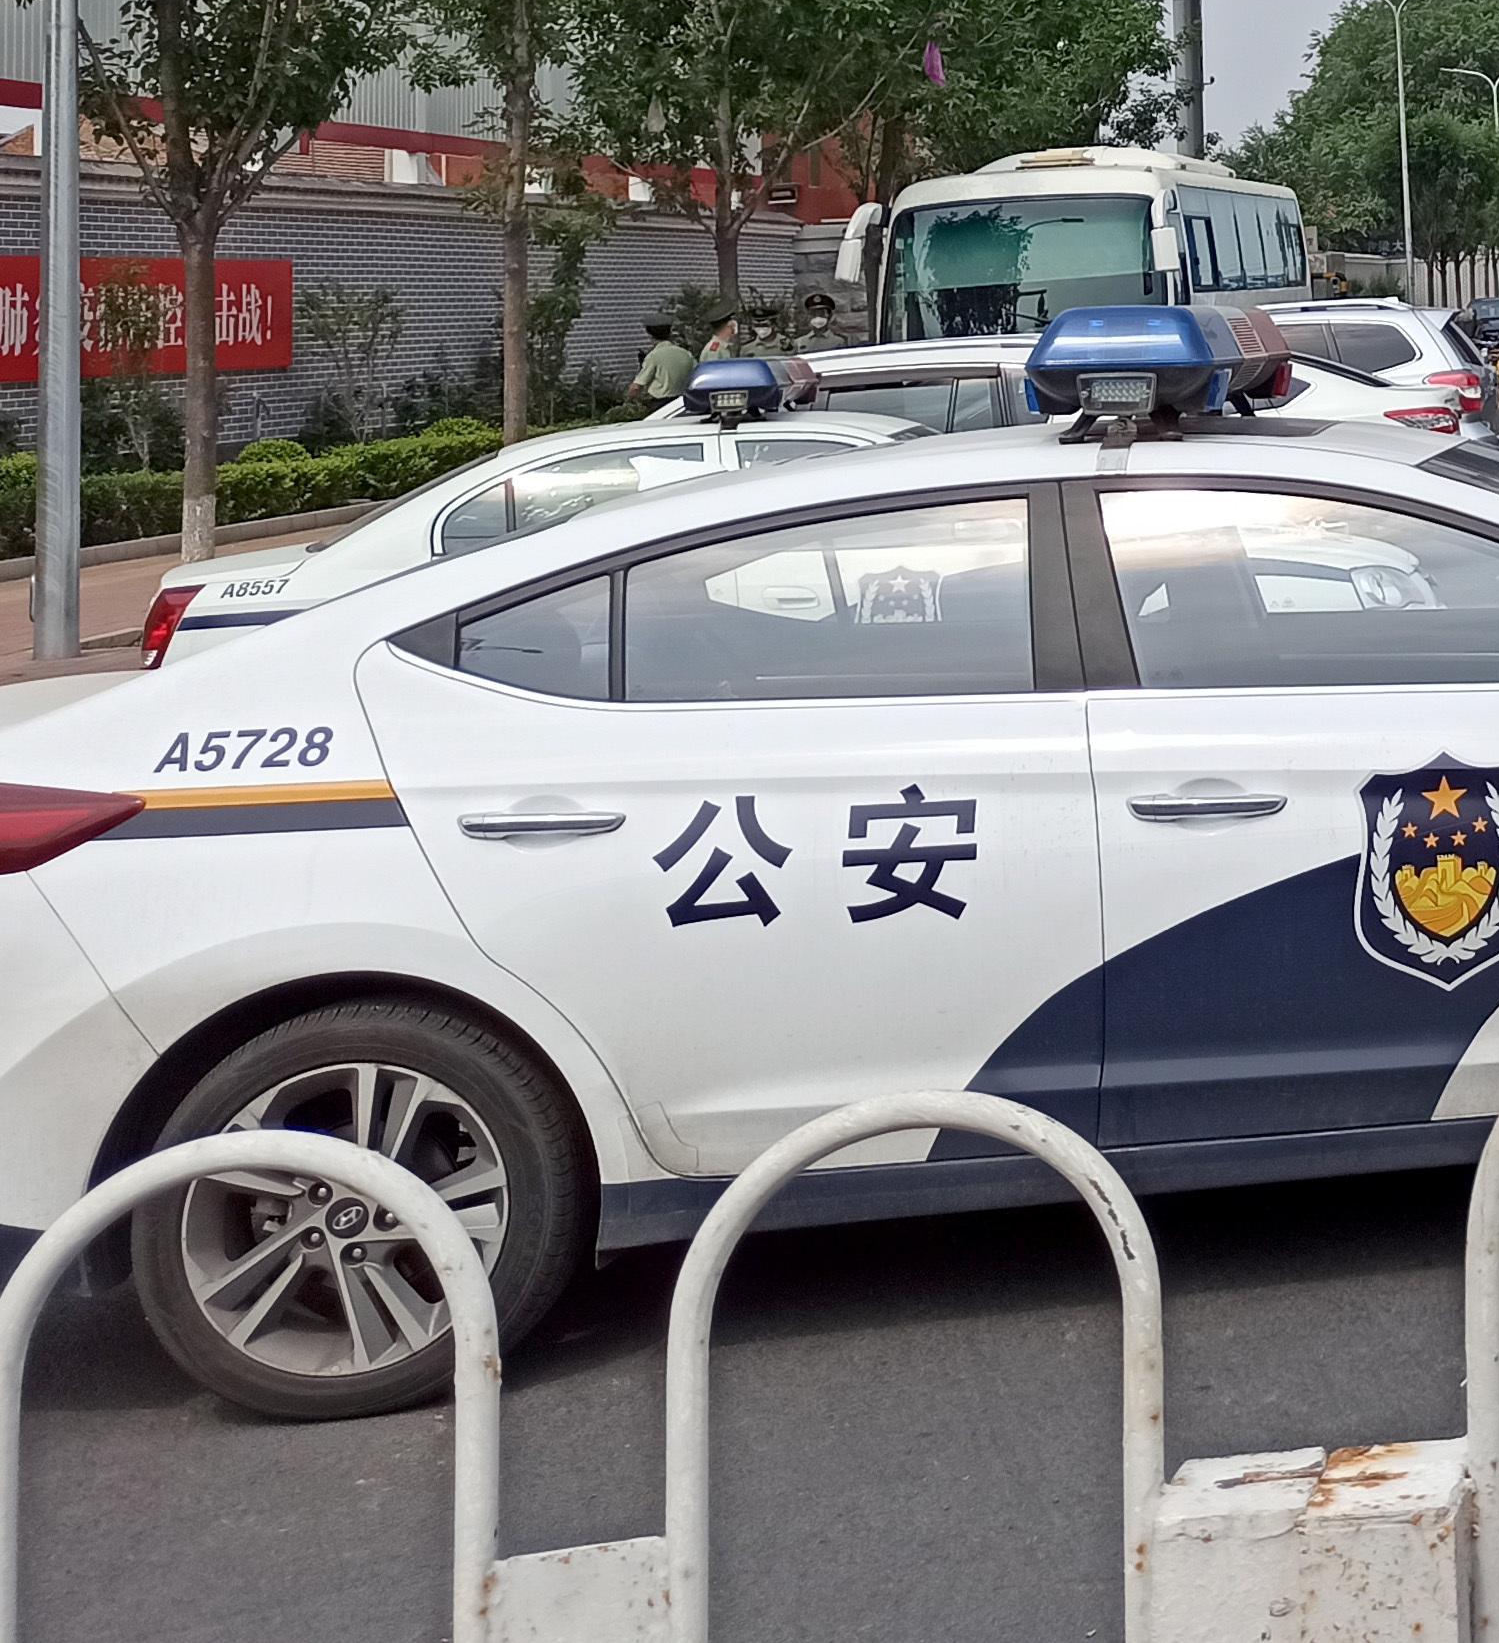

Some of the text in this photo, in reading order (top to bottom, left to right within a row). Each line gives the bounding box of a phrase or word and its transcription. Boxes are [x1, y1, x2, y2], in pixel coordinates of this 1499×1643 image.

[220, 577, 291, 599] A8557
[153, 725, 335, 774] A5728
[652, 783, 979, 929] 公安
